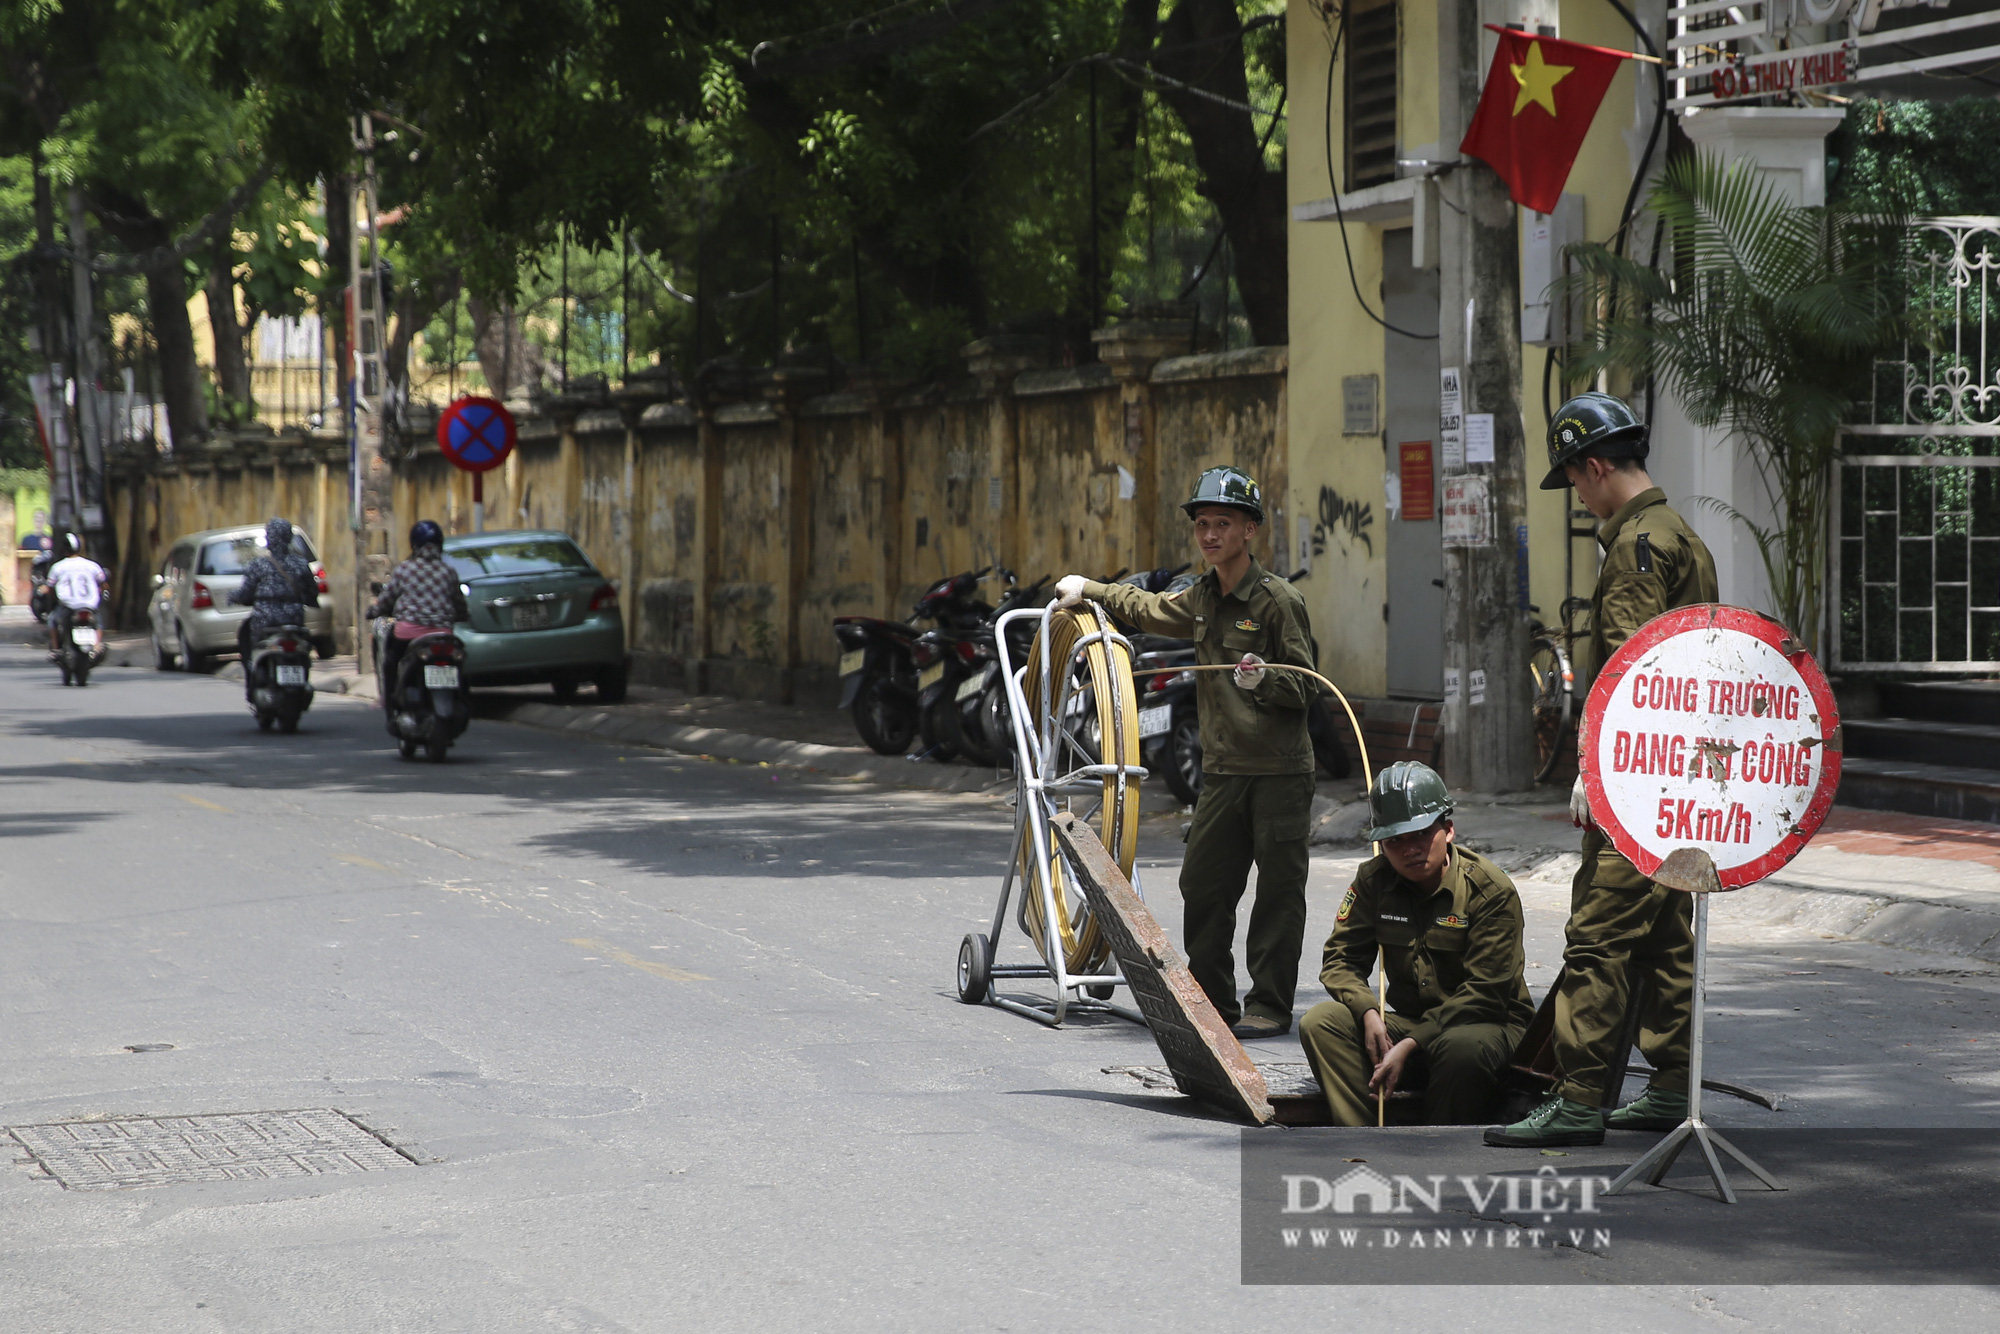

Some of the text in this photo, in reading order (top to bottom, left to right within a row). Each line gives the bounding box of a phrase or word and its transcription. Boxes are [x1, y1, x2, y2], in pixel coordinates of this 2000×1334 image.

[63, 572, 89, 598] 13
[1631, 667, 1800, 721] CÔNG TRƯỜNG
[1613, 730, 1686, 778] ĐANG
[1741, 732, 1812, 787] CÔNG
[1656, 797, 1752, 845] 5Km/h
